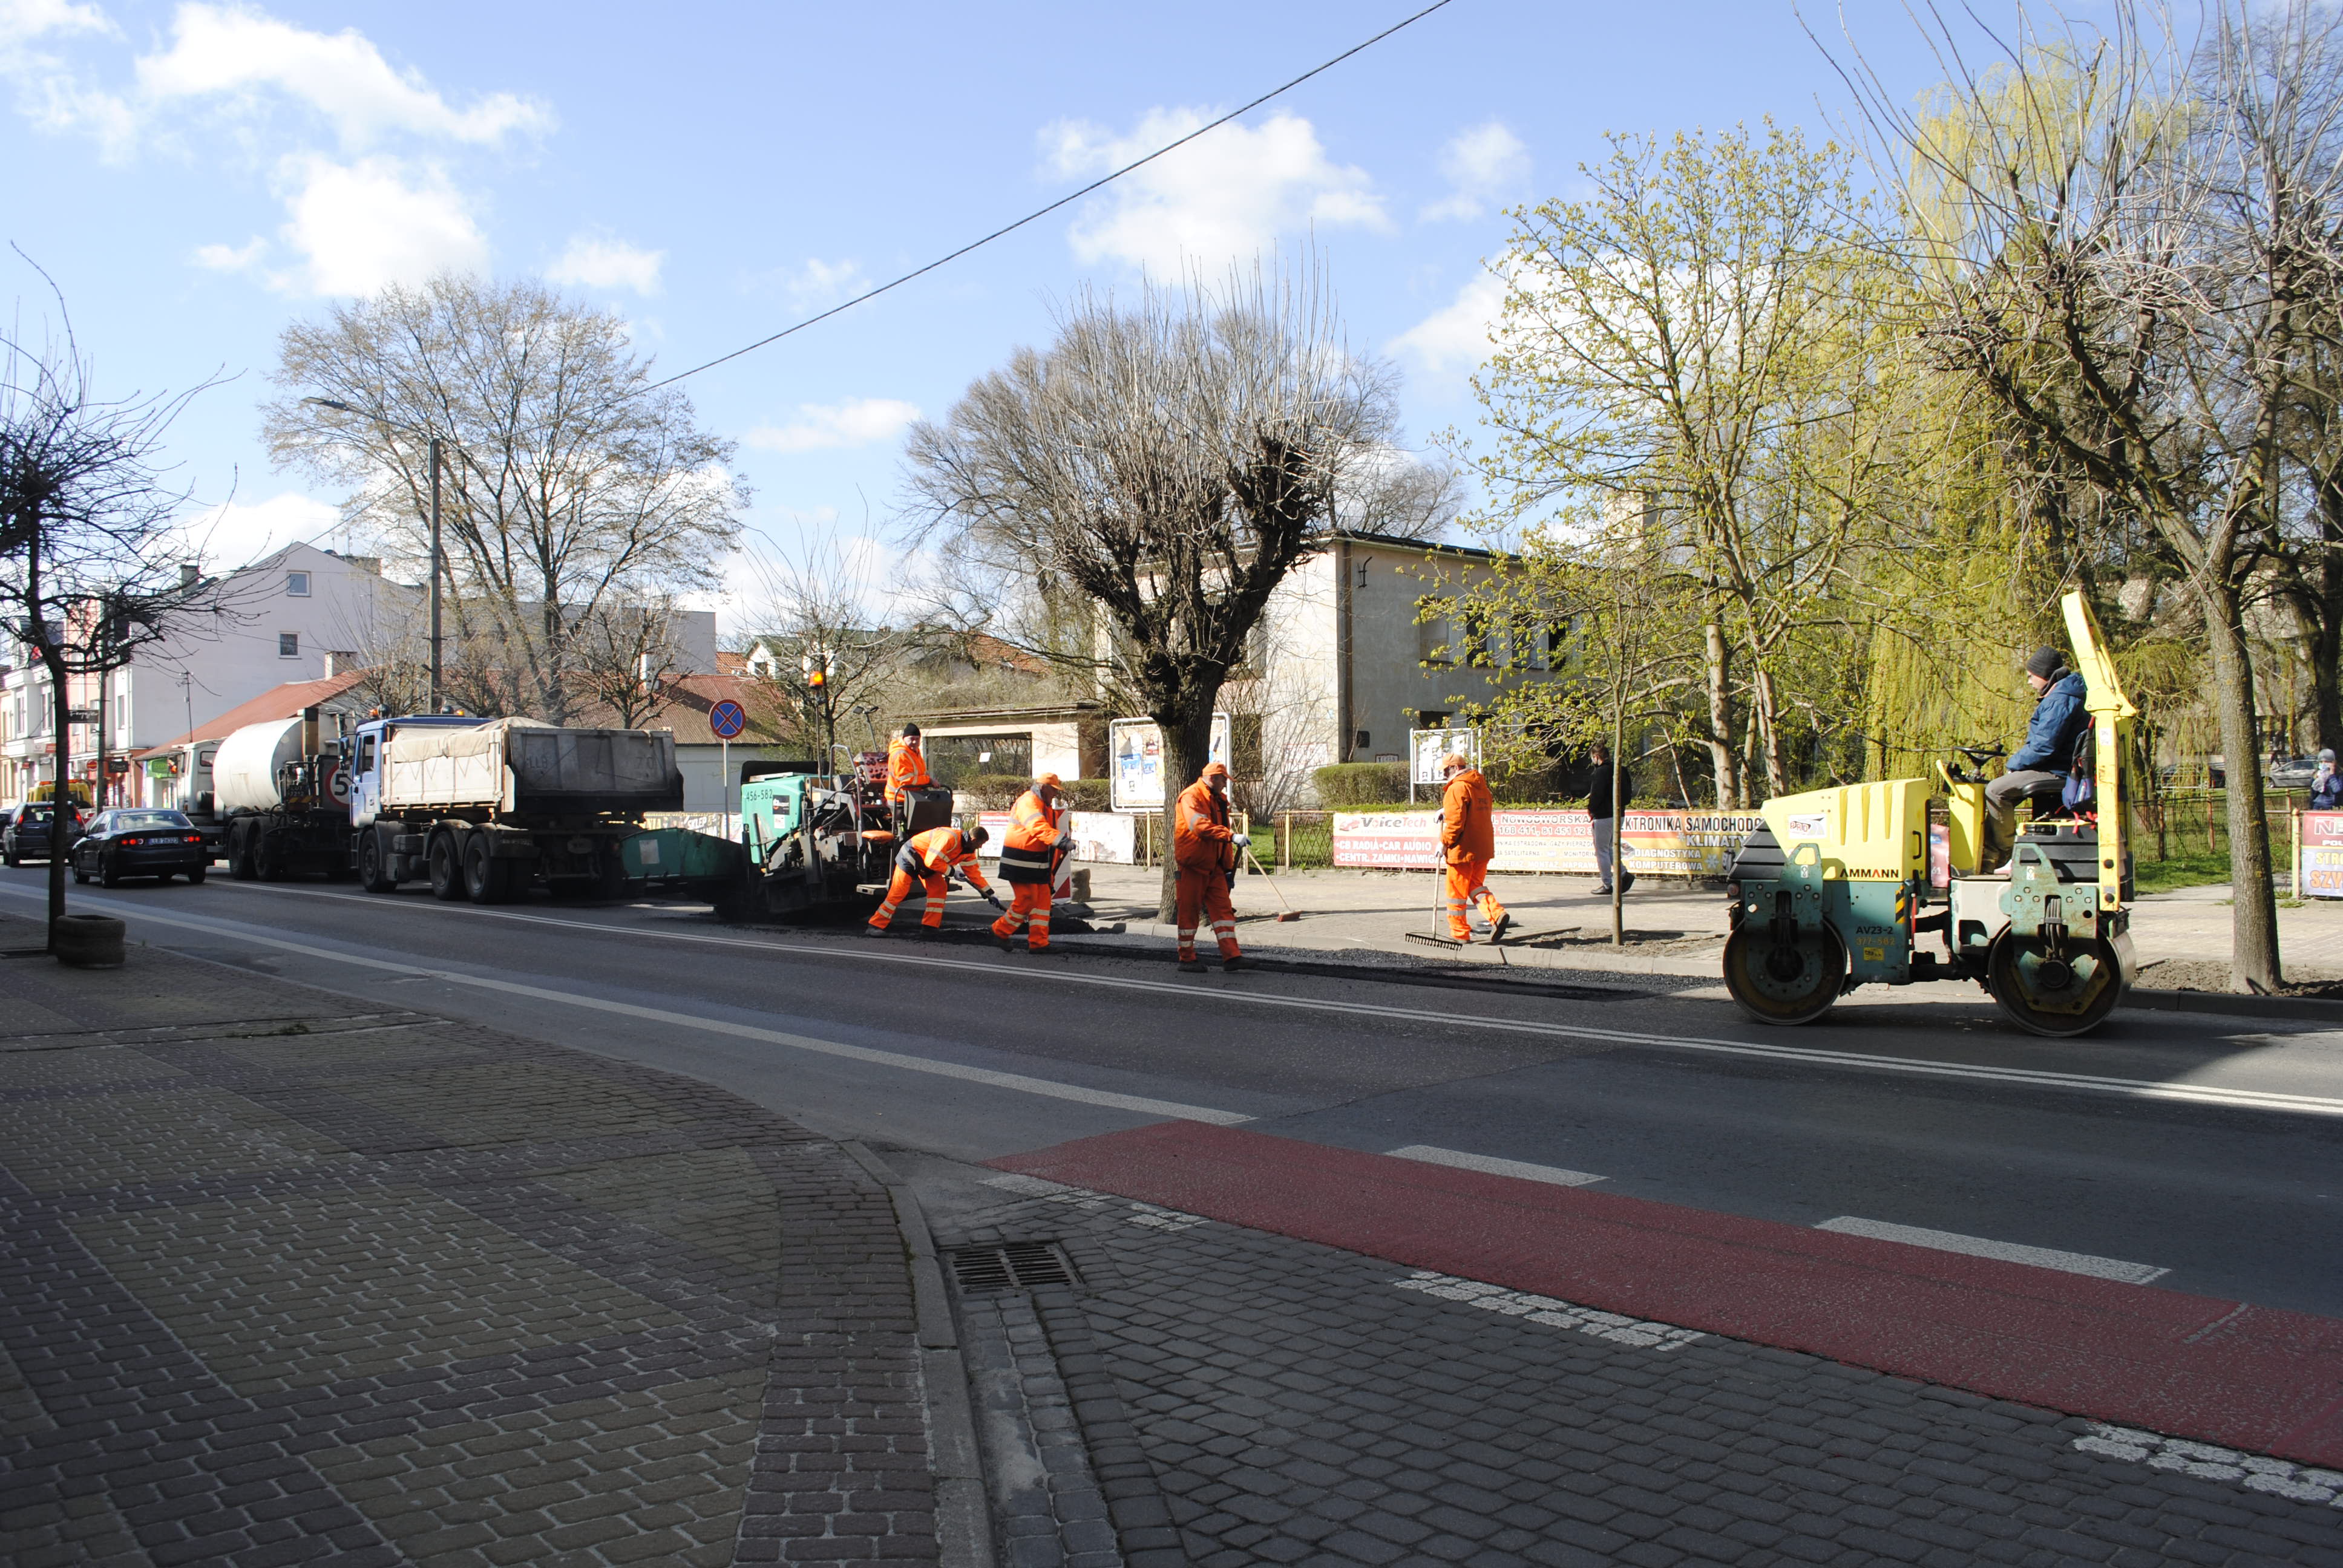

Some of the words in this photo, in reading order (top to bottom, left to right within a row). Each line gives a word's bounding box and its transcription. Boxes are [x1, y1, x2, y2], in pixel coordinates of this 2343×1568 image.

[335, 774, 349, 796] 5
[746, 789, 773, 802] 456-582
[687, 816, 707, 830] SKLEP
[1361, 817, 1426, 828] VoiceTech
[1502, 815, 1590, 824] NOWODWORSKA
[1623, 817, 1682, 831] KTRONIKA
[1403, 841, 1432, 851] AUDIO
[1686, 835, 1745, 847] KLIMATY
[1634, 849, 1702, 858] DIAGNOSTYKA
[1629, 860, 1703, 871] KOMPUTEROWA
[1840, 869, 1899, 878] AMMANN
[2310, 870, 2343, 889] SZY
[1855, 926, 1893, 935] AV23-2
